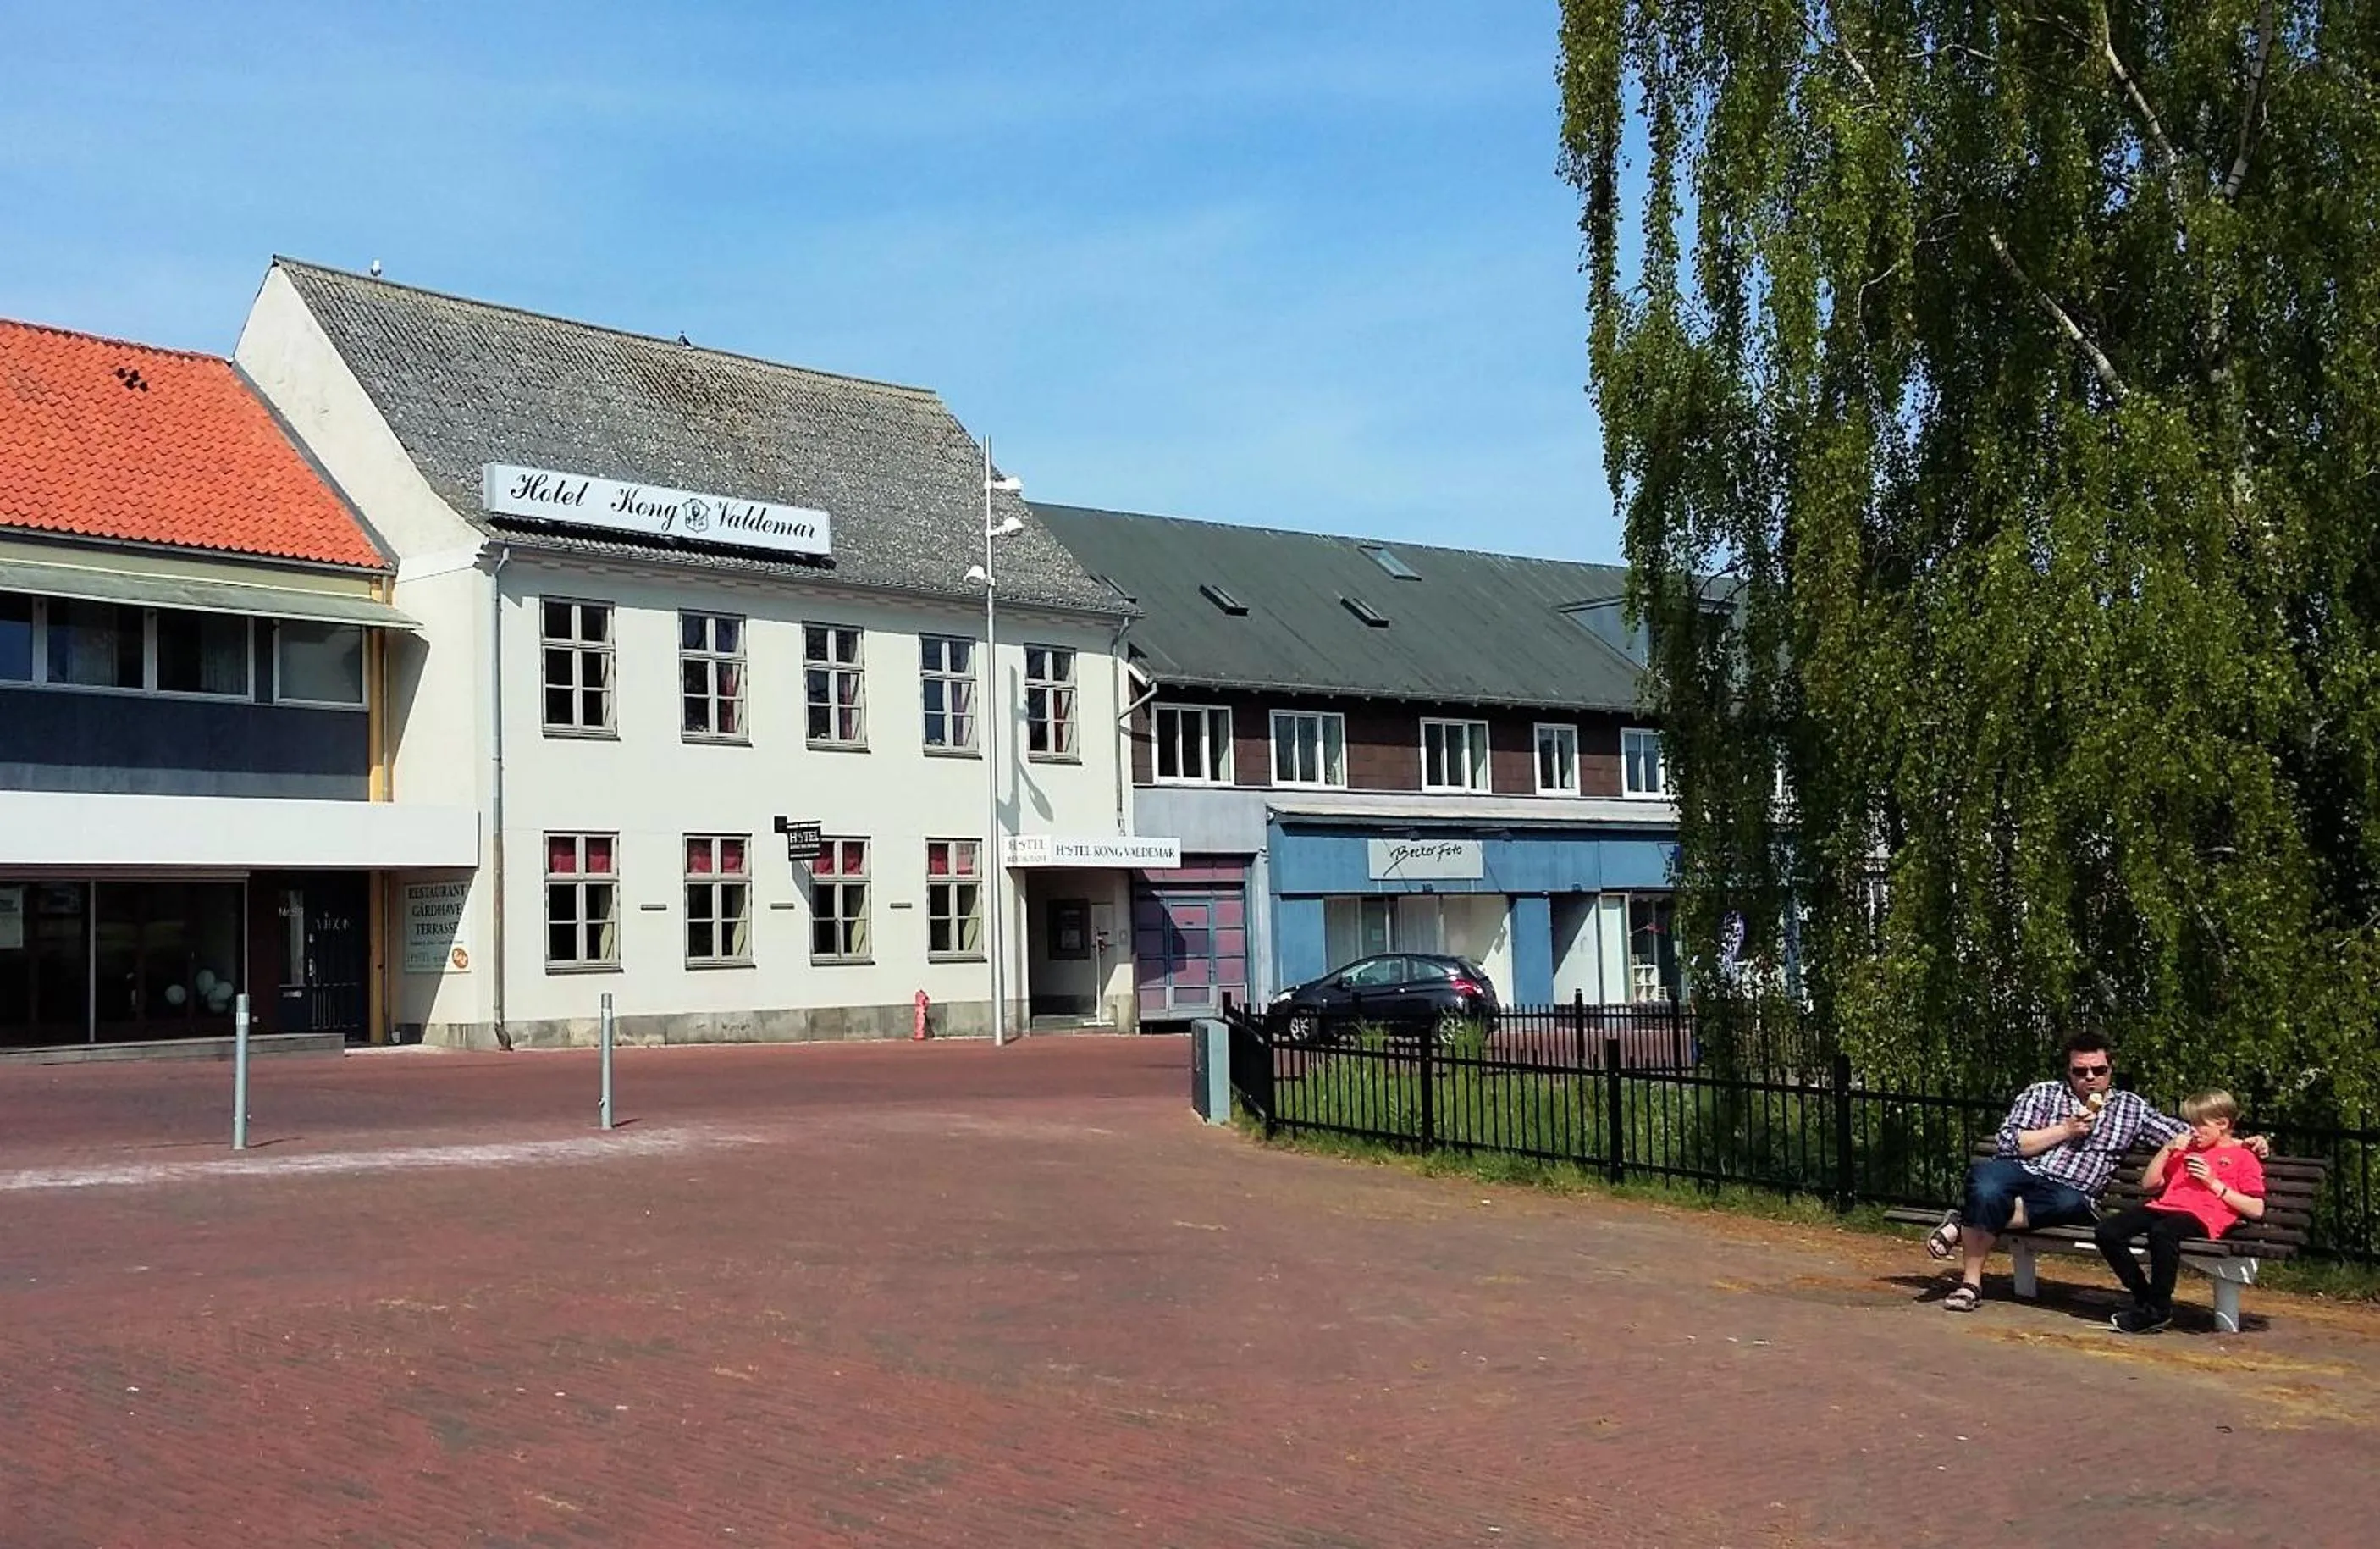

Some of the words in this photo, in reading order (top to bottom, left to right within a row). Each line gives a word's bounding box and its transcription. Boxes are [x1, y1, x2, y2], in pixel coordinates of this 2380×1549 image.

[510, 473, 589, 507] Hotel
[610, 487, 678, 533] Kong
[713, 501, 815, 539] Valdemar
[1094, 845, 1123, 858] KONG
[1124, 846, 1175, 859] VALDEMAR
[408, 883, 467, 899] RESTAURANT
